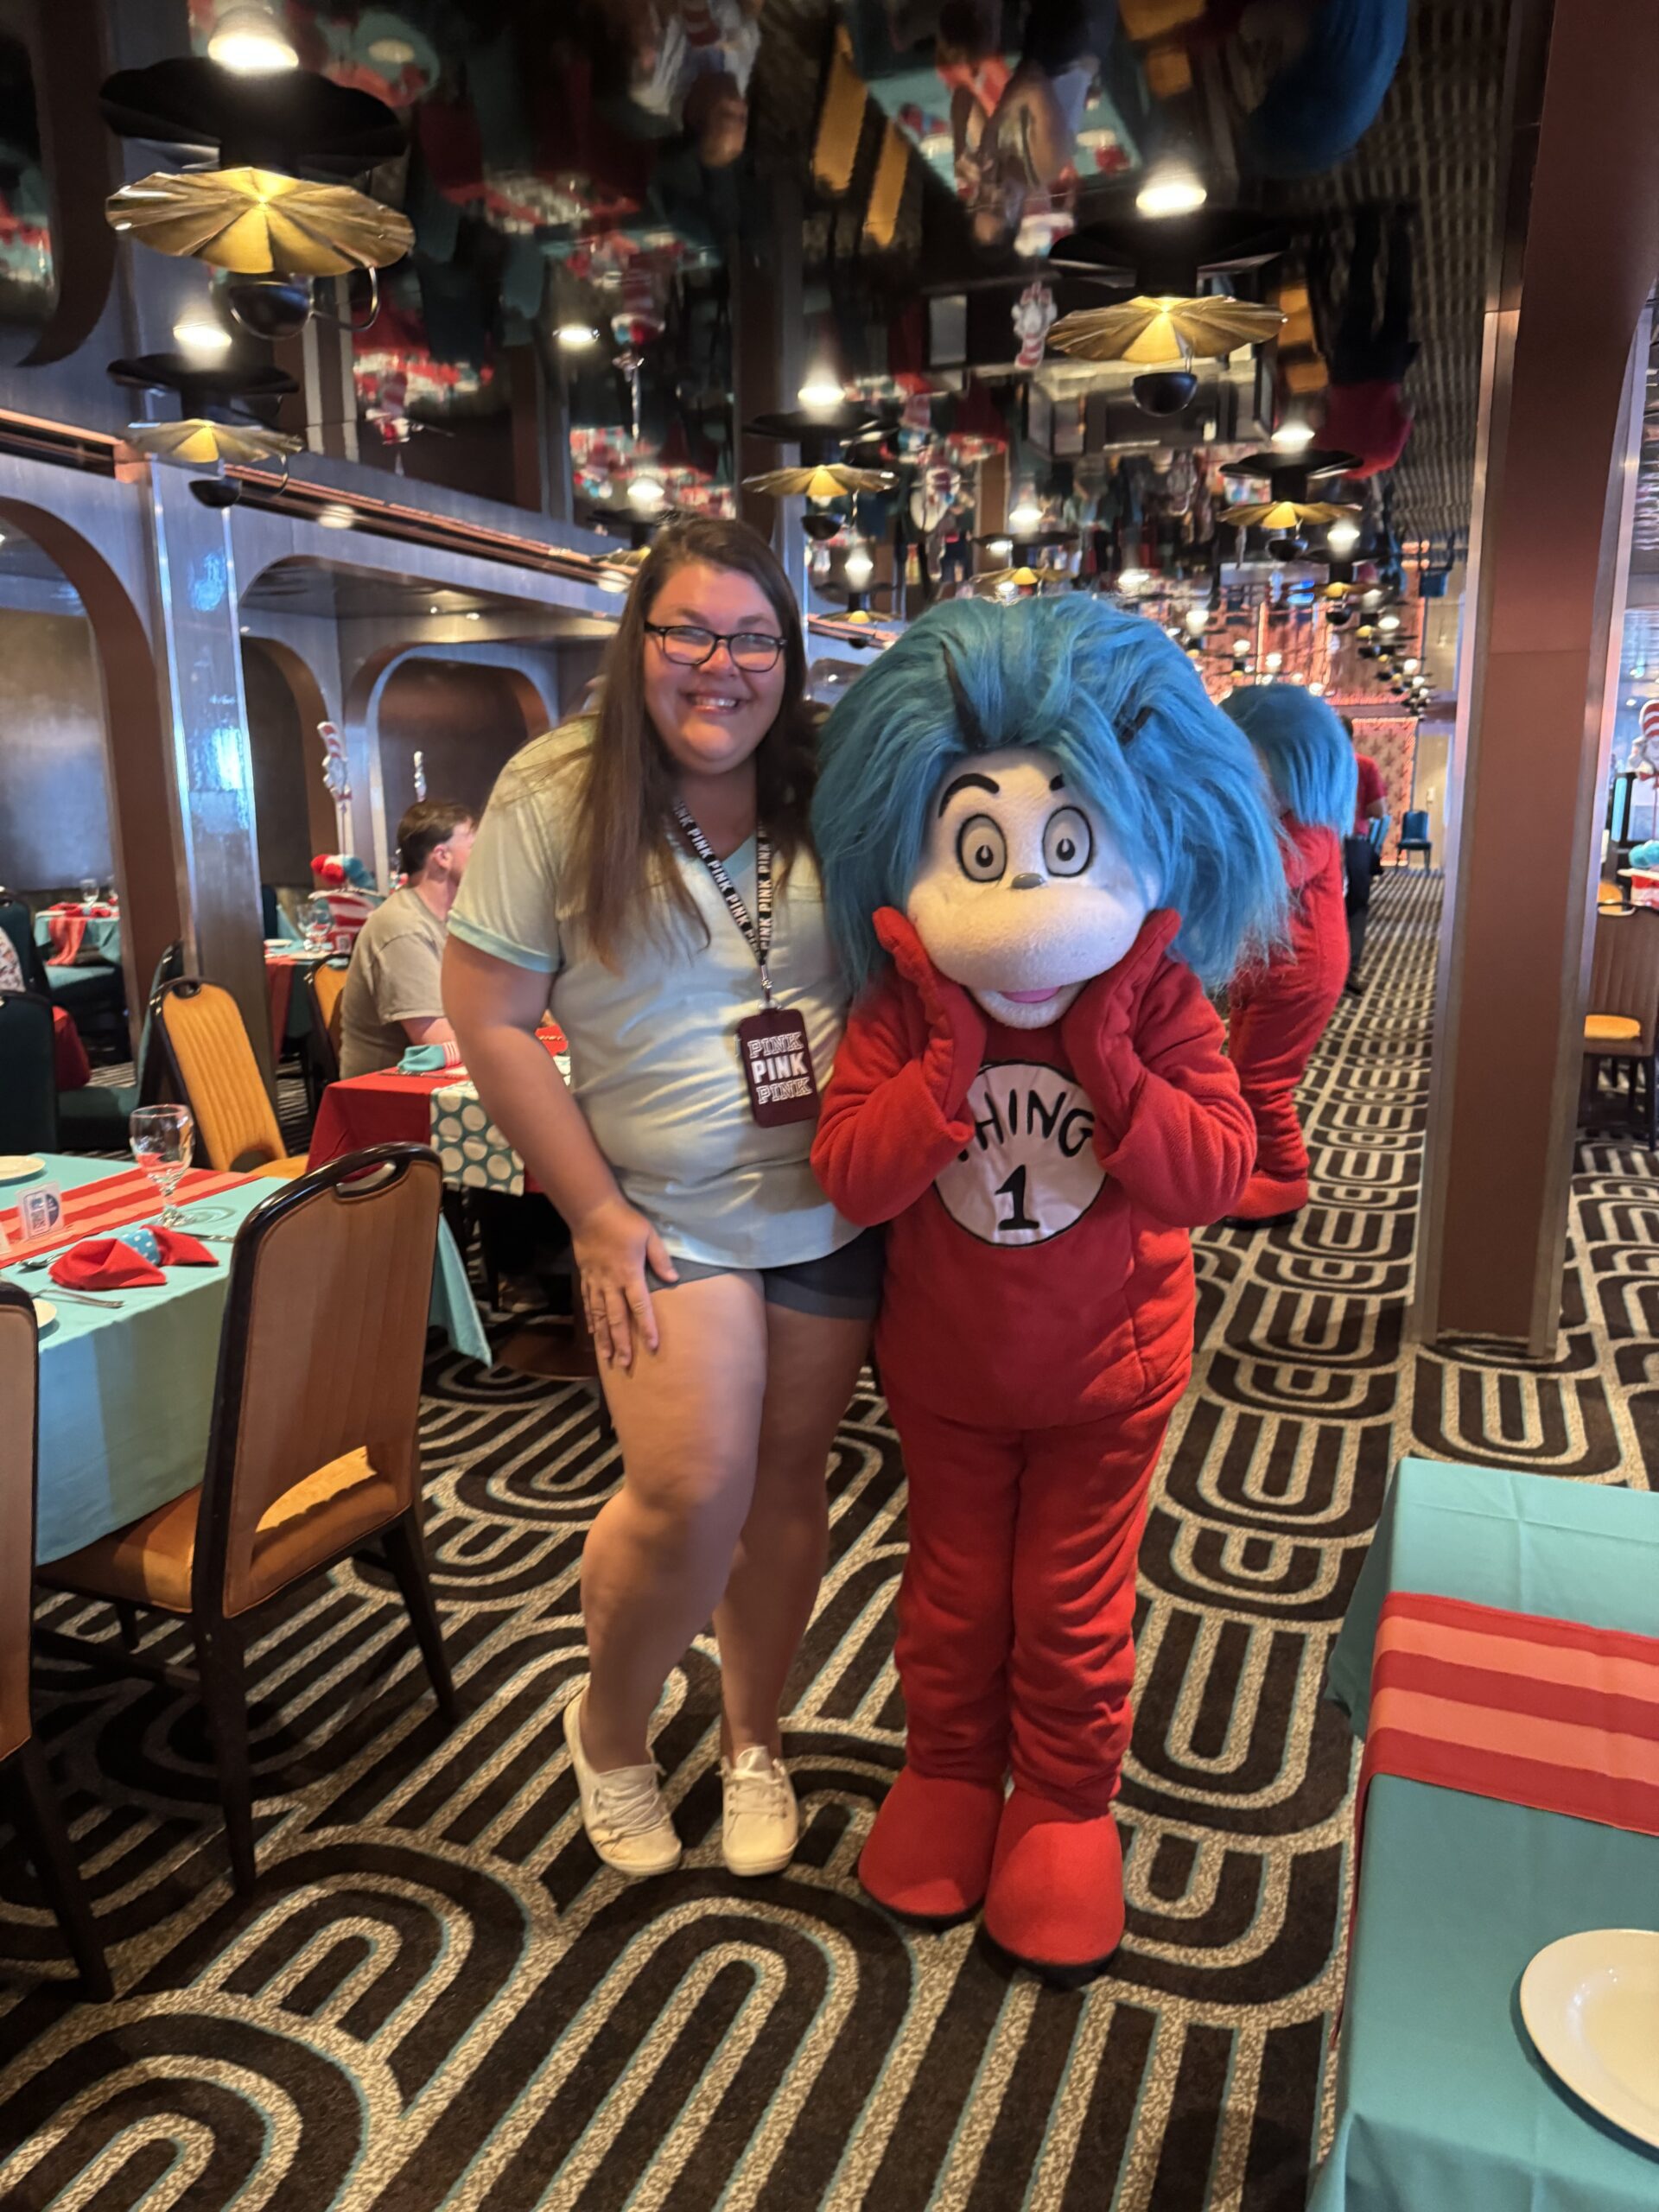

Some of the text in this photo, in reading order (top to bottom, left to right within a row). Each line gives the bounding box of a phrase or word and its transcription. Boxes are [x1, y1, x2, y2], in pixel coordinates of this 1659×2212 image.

[673, 802, 694, 828] INK
[687, 827, 712, 859] PINK
[707, 859, 732, 893] PINK
[725, 893, 749, 926] PINK
[757, 843, 771, 874] PINK
[758, 879, 772, 912] PINK
[758, 918, 772, 950] PINK
[747, 1031, 804, 1059] PINK
[751, 1052, 808, 1084] PINK
[756, 1077, 813, 1105] PINK
[957, 1088, 1096, 1162] HING
[994, 1164, 1040, 1231] 1
